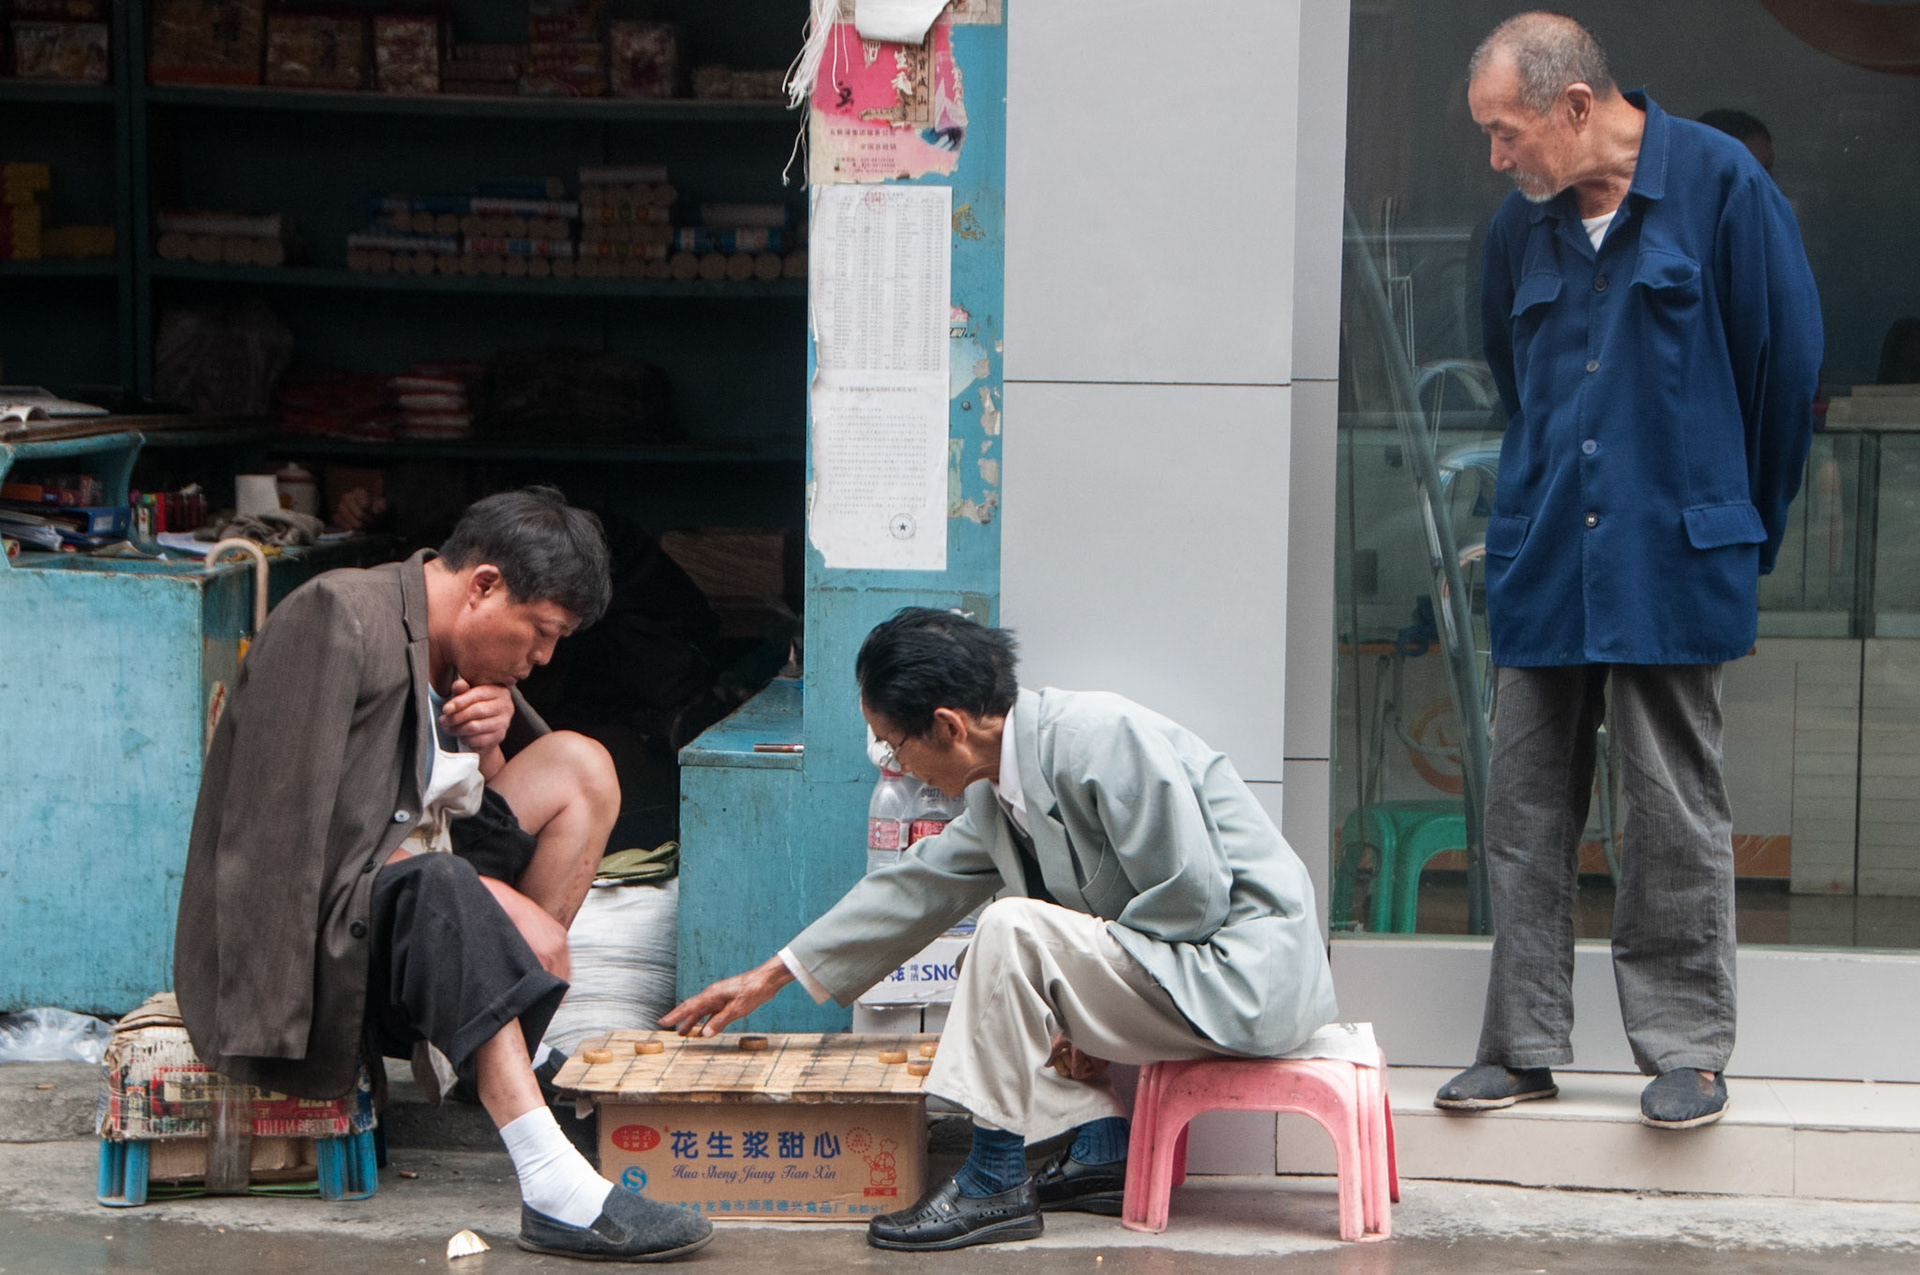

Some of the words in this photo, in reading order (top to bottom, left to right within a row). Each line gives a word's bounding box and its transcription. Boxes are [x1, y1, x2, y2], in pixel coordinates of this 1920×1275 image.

[670, 1130, 841, 1159] 花生浆甜心
[672, 1164, 698, 1179] Hua
[702, 1164, 737, 1184] Sheng
[738, 1164, 776, 1184] Jiang
[781, 1164, 809, 1179] Tian
[813, 1164, 837, 1179] Xin
